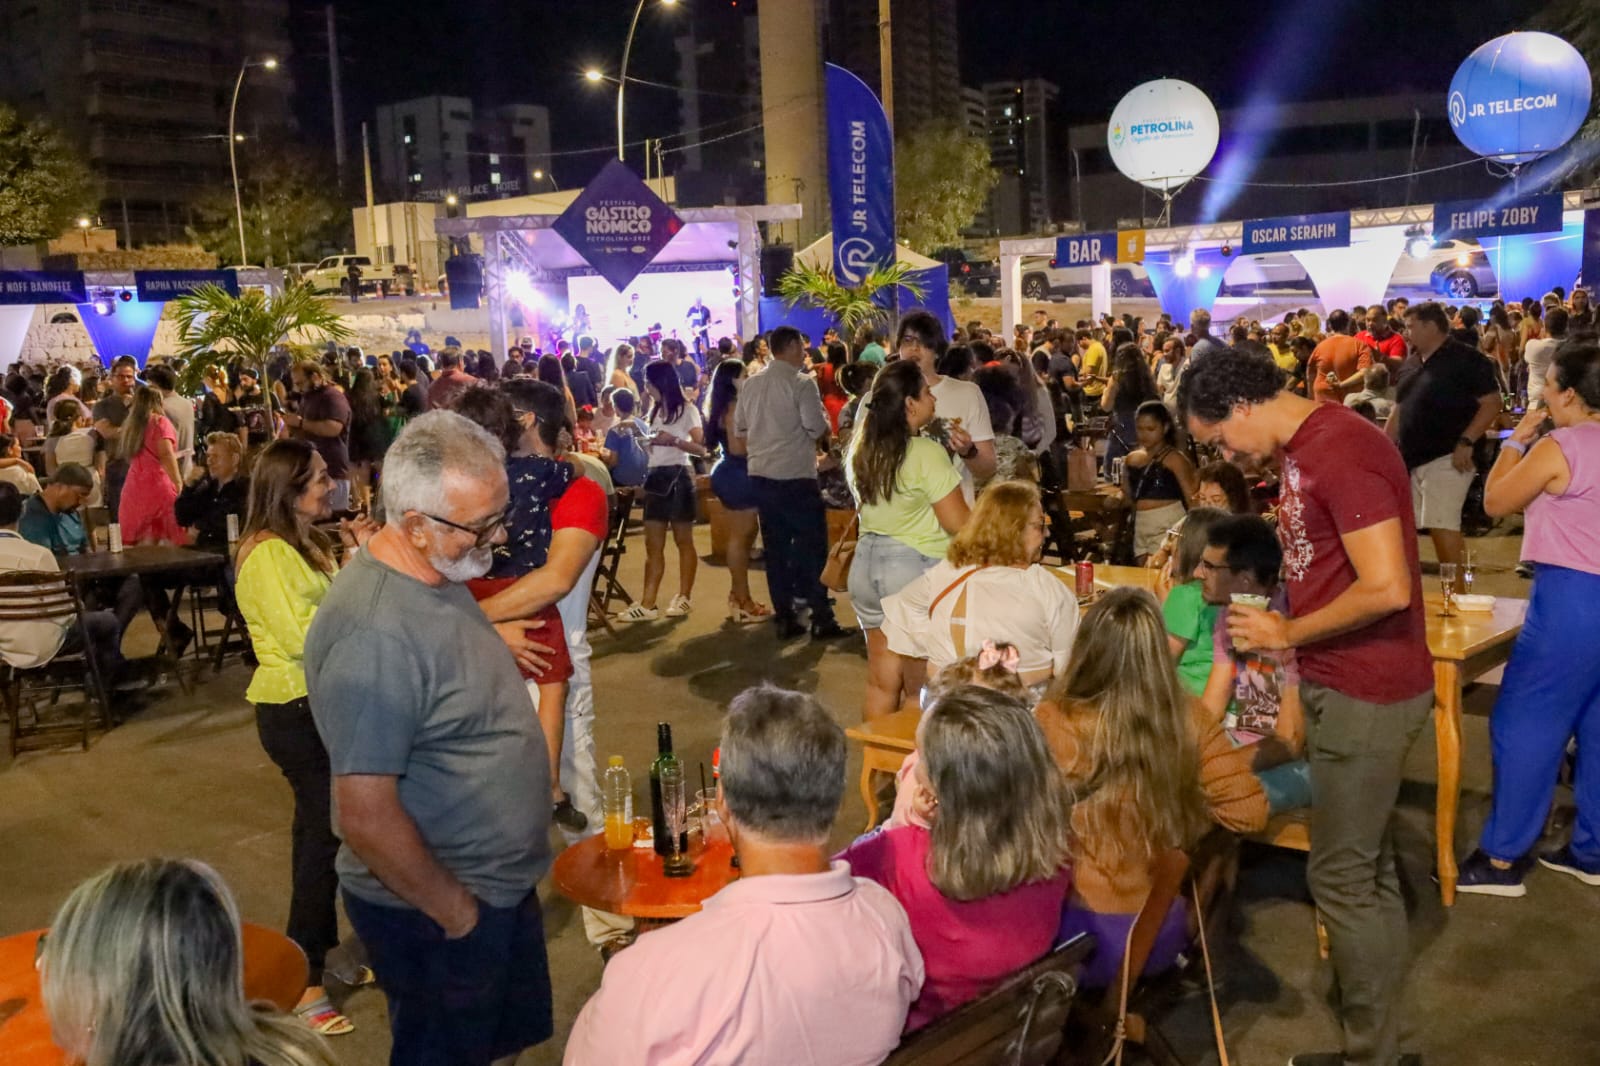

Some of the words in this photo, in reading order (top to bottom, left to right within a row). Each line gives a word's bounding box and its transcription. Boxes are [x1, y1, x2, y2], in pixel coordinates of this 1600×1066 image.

[1468, 103, 1486, 117] JR
[1488, 93, 1558, 115] TELECOM
[1130, 120, 1194, 135] PETROLINA
[851, 120, 867, 205] TELECOM
[495, 179, 520, 192] HOTEL
[585, 206, 652, 220] GASTRO
[852, 210, 867, 232] JR
[1451, 209, 1496, 231] FELIPE
[1501, 206, 1539, 227] ZOBY
[1251, 227, 1287, 244] OSCAR
[1290, 223, 1336, 241] SERAFIM
[1069, 238, 1101, 263] BAR
[145, 280, 171, 290] RAPHA
